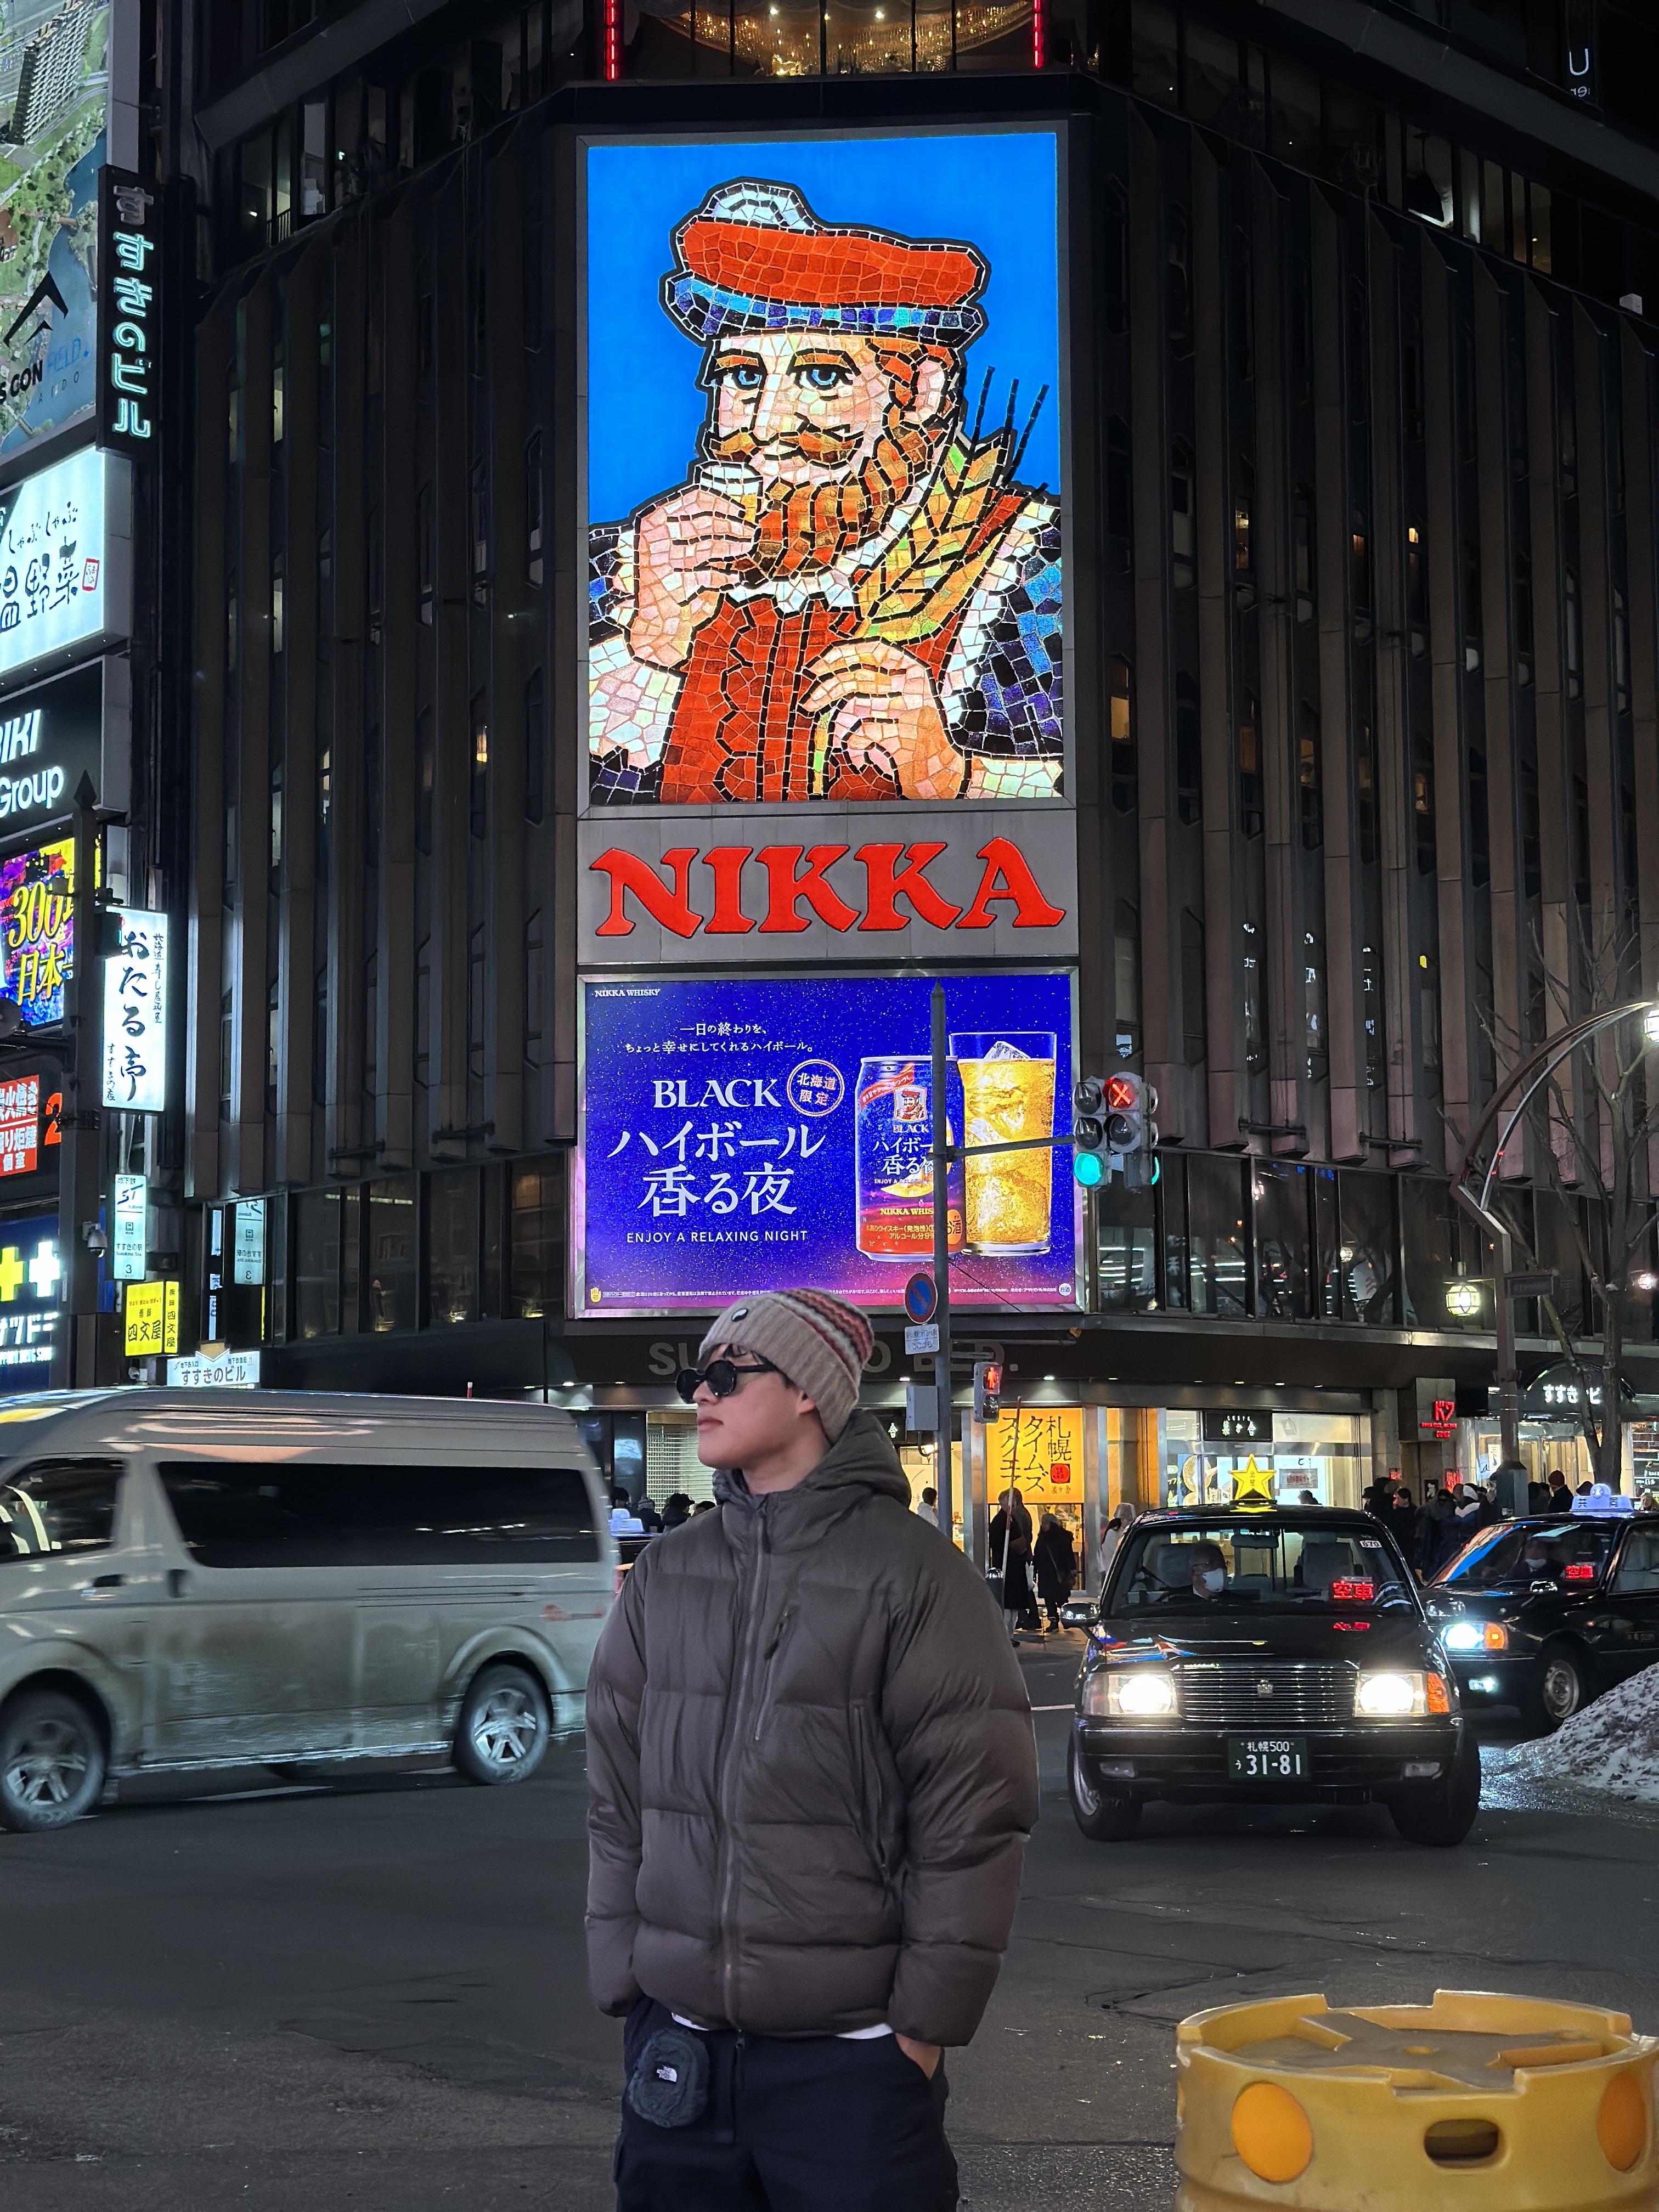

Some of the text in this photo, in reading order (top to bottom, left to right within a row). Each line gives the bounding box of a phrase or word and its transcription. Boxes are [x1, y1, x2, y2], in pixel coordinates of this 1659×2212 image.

[112, 185, 154, 439] すすきのビル
[10, 360, 43, 397] CON
[9, 501, 78, 554] しゃぶしゃぶ
[0, 709, 41, 764] IKI
[0, 766, 64, 818] Group
[589, 837, 1065, 939] NIKKA
[627, 989, 661, 997] WHISKY
[680, 1022, 768, 1037] 一日の終わりを、
[624, 1041, 813, 1054] ちょっと幸せにしてくれるハイボール。
[796, 1073, 837, 1091] 北海道
[653, 1079, 783, 1108] BLACK
[798, 1090, 830, 1107] 限定
[893, 1124, 930, 1133] BLACK
[607, 1120, 826, 1162] ハイボール
[872, 1137, 934, 1154] ハイボー
[637, 1162, 798, 1218] 香る夜
[627, 1230, 808, 1243] ENJOY A RELAXING NIGHT
[126, 1265, 132, 1274] 3
[128, 1319, 161, 1342] 四文屋
[182, 1365, 246, 1386] すすきのビル
[1046, 1415, 1071, 1462] 札幌
[1023, 1415, 1049, 1492] タイムズ
[1331, 1580, 1374, 1601] 空車
[1247, 1741, 1290, 1752] 札幌500
[1246, 1754, 1301, 1775] 31-81
